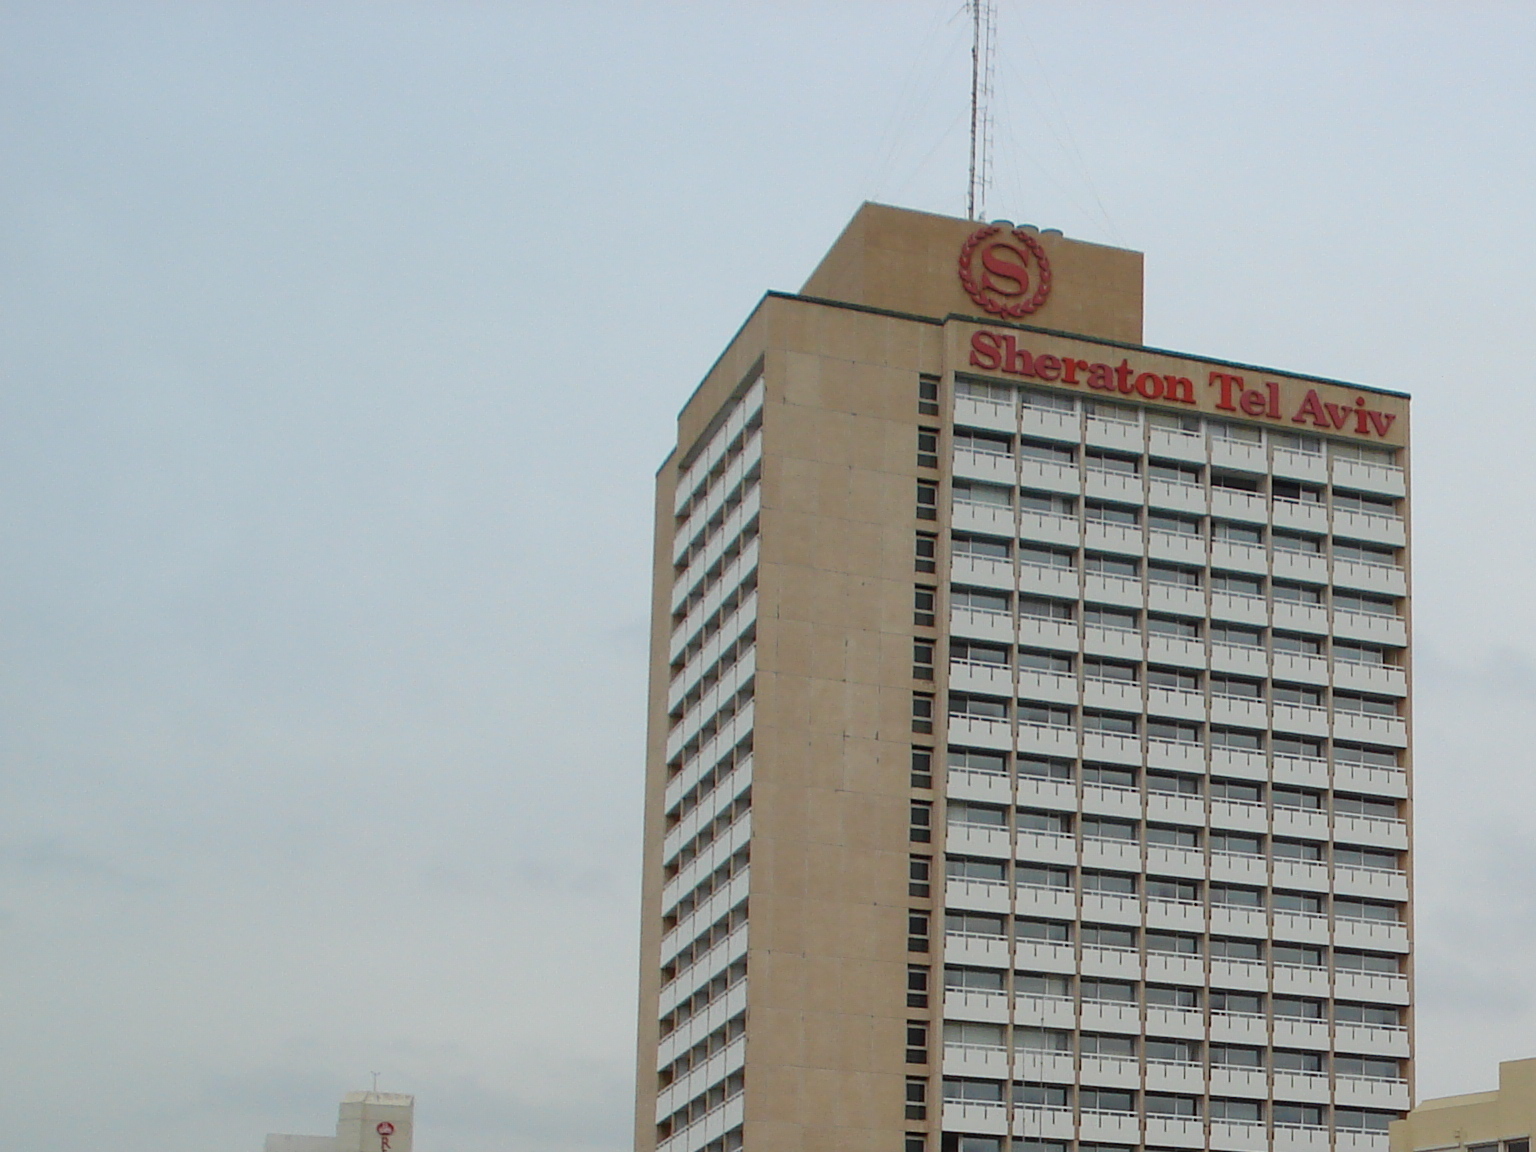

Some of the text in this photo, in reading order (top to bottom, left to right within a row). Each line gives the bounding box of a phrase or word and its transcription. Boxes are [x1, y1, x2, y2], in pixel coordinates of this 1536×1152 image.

[970, 330, 1396, 437] Sheraton Tel Aviv
